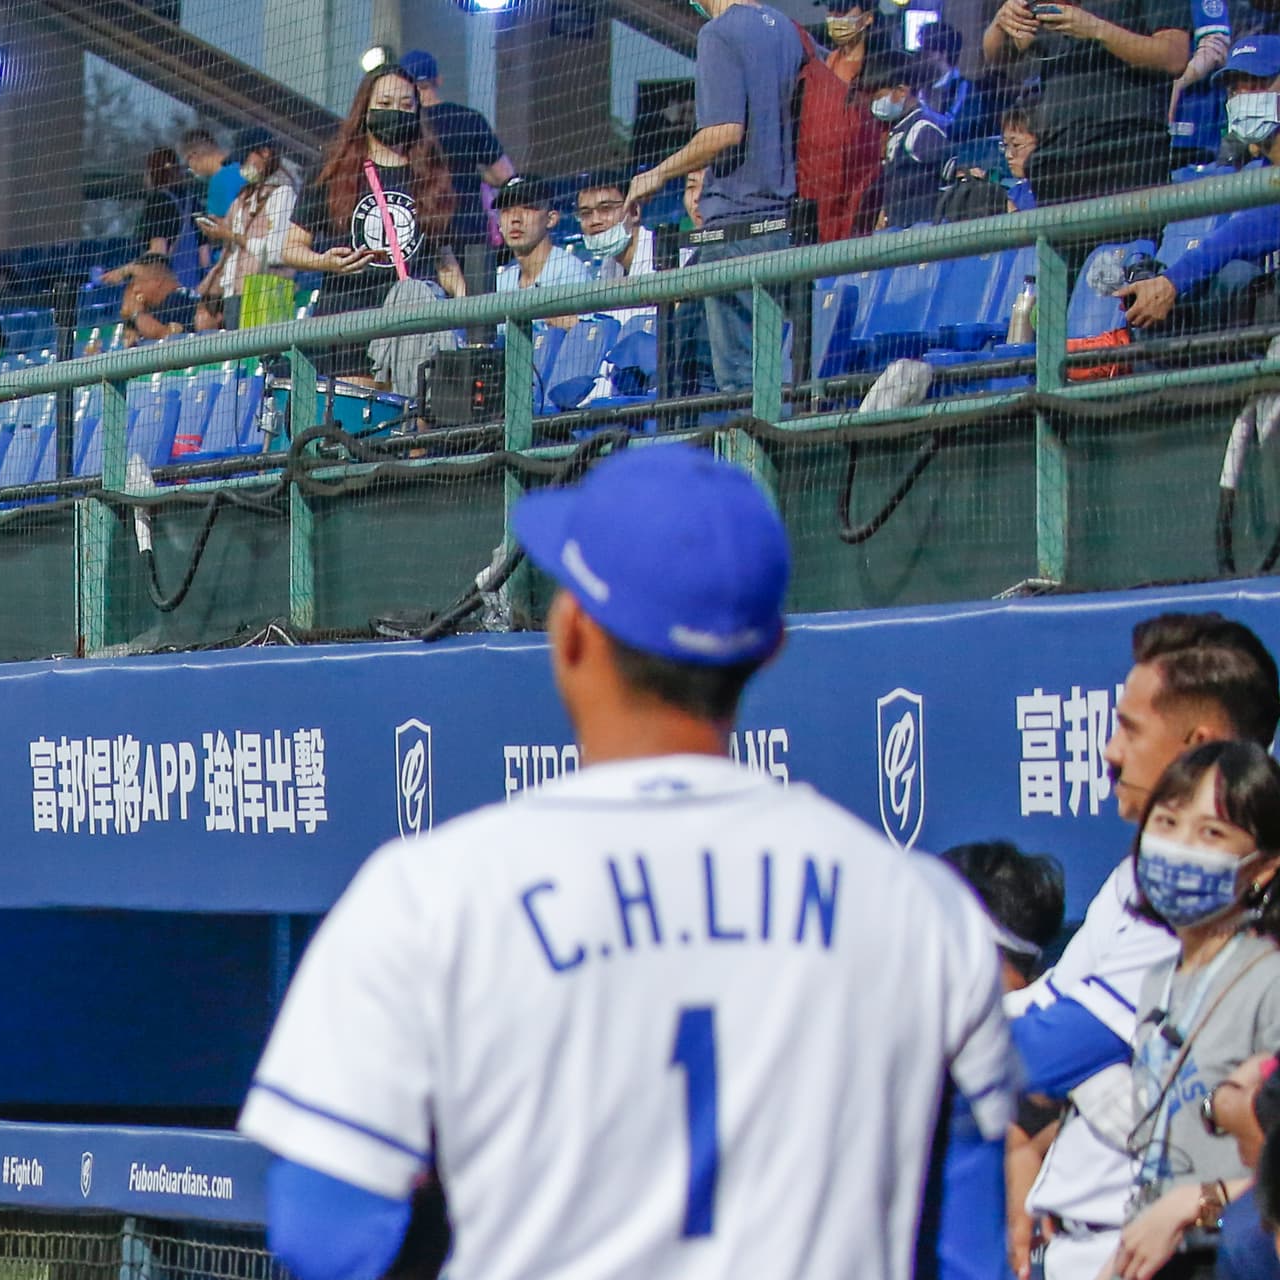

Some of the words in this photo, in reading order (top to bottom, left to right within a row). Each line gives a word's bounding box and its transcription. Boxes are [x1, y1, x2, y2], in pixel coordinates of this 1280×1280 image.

[345, 194, 416, 220] BROKLY
[520, 849, 845, 976] C.H.LIN
[670, 1006, 722, 1238] 1
[129, 1162, 233, 1200] FubonGuardians.com
